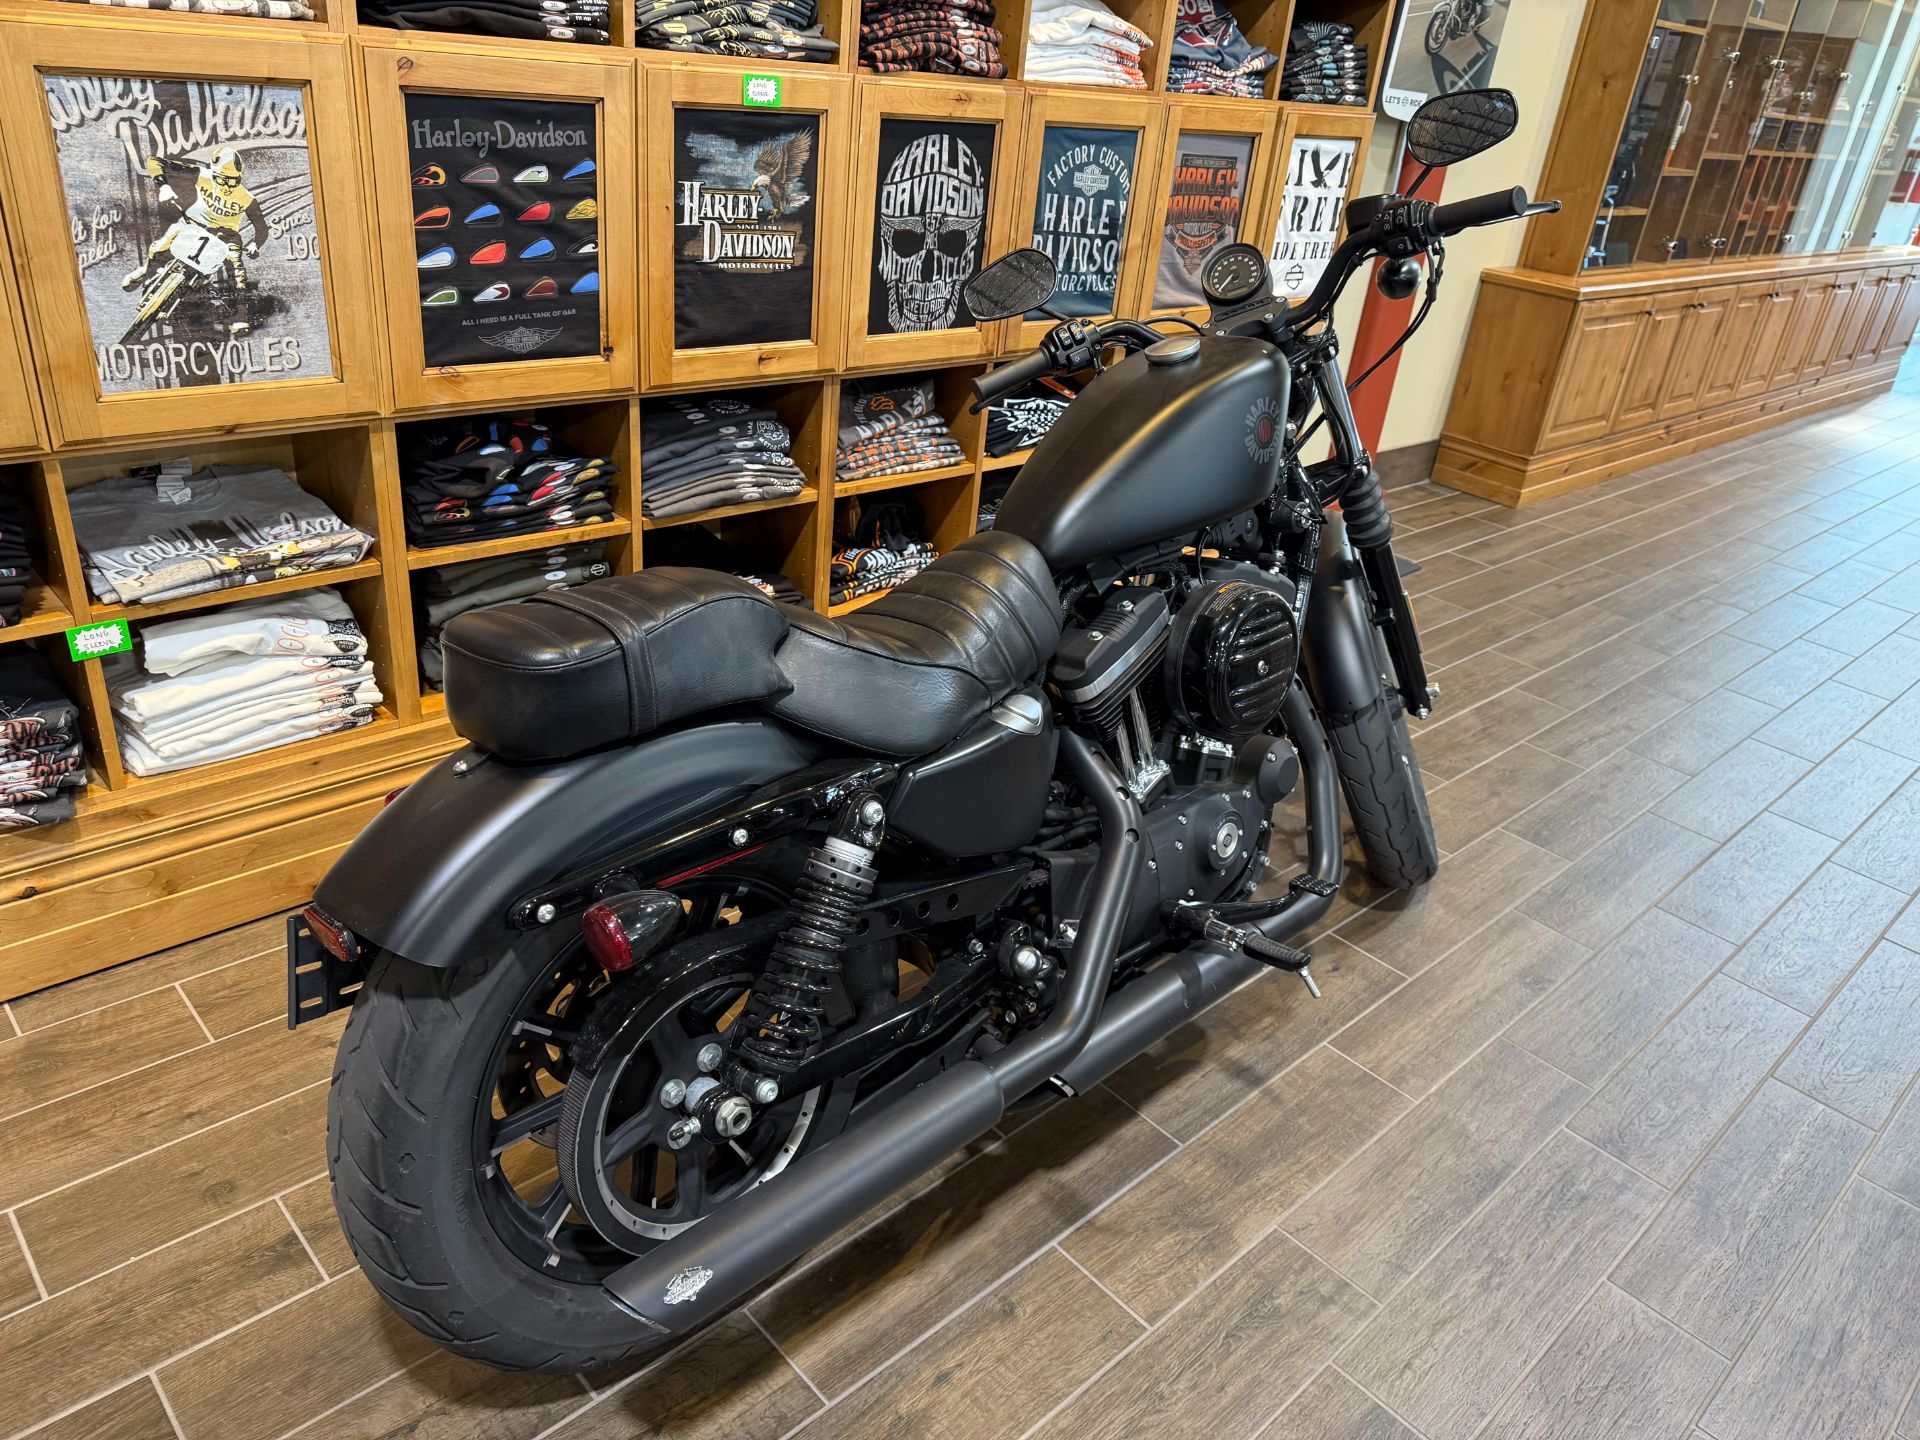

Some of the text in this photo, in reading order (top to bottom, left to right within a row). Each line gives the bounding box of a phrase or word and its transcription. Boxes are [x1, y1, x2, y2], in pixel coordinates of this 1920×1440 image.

[412, 118, 588, 158] Harley-Davidson
[1046, 144, 1096, 188] FACTORY
[199, 184, 245, 213] HARLEY
[675, 180, 764, 226] HARLEY-
[880, 173, 985, 218] DAVIDSON
[268, 211, 315, 240] Since
[1043, 193, 1128, 239] HARLEY
[78, 231, 119, 277] peed
[197, 236, 211, 265] 1
[285, 233, 321, 263] 190
[695, 219, 795, 263] DAVIDSON
[1273, 241, 1299, 260] IDE
[718, 262, 792, 270] MOTORCYCLES
[1056, 274, 1117, 292] TORCYCLES
[480, 316, 499, 324] NEED
[96, 336, 303, 384] MOTORCYCLES
[1245, 396, 1280, 427] HARLEY
[83, 630, 109, 641] LONG
